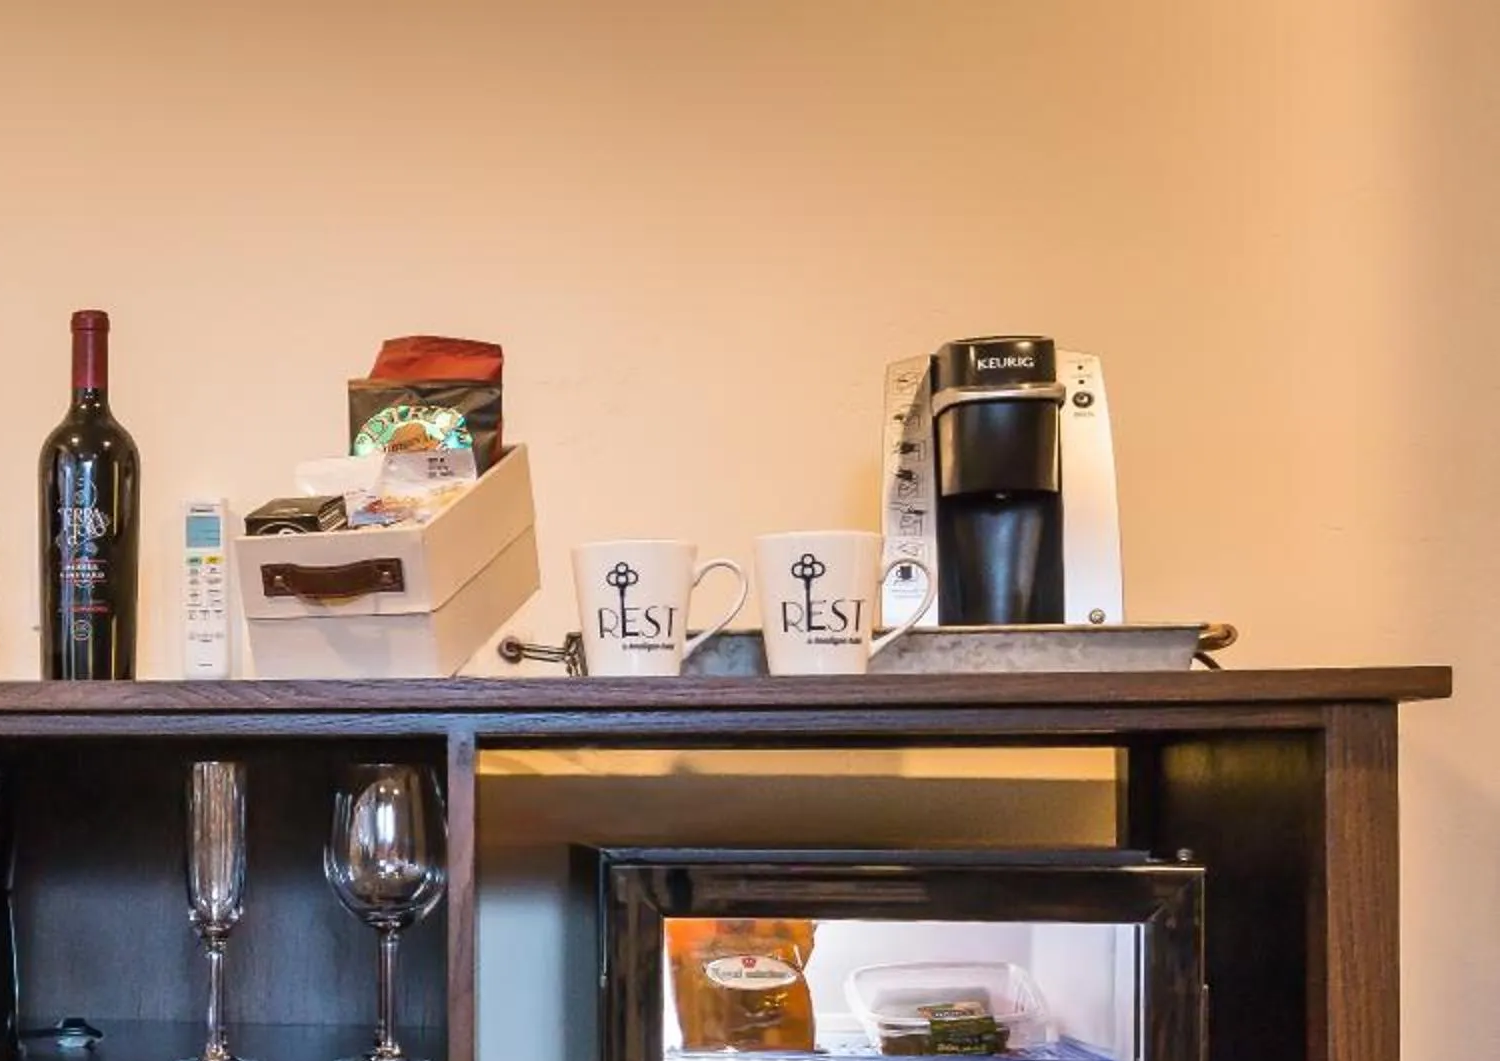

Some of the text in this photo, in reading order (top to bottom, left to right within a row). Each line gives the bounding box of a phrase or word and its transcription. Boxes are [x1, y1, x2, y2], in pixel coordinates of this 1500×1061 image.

[977, 356, 1035, 370] KEURIG
[598, 605, 678, 638] REST
[781, 599, 865, 632] REST
